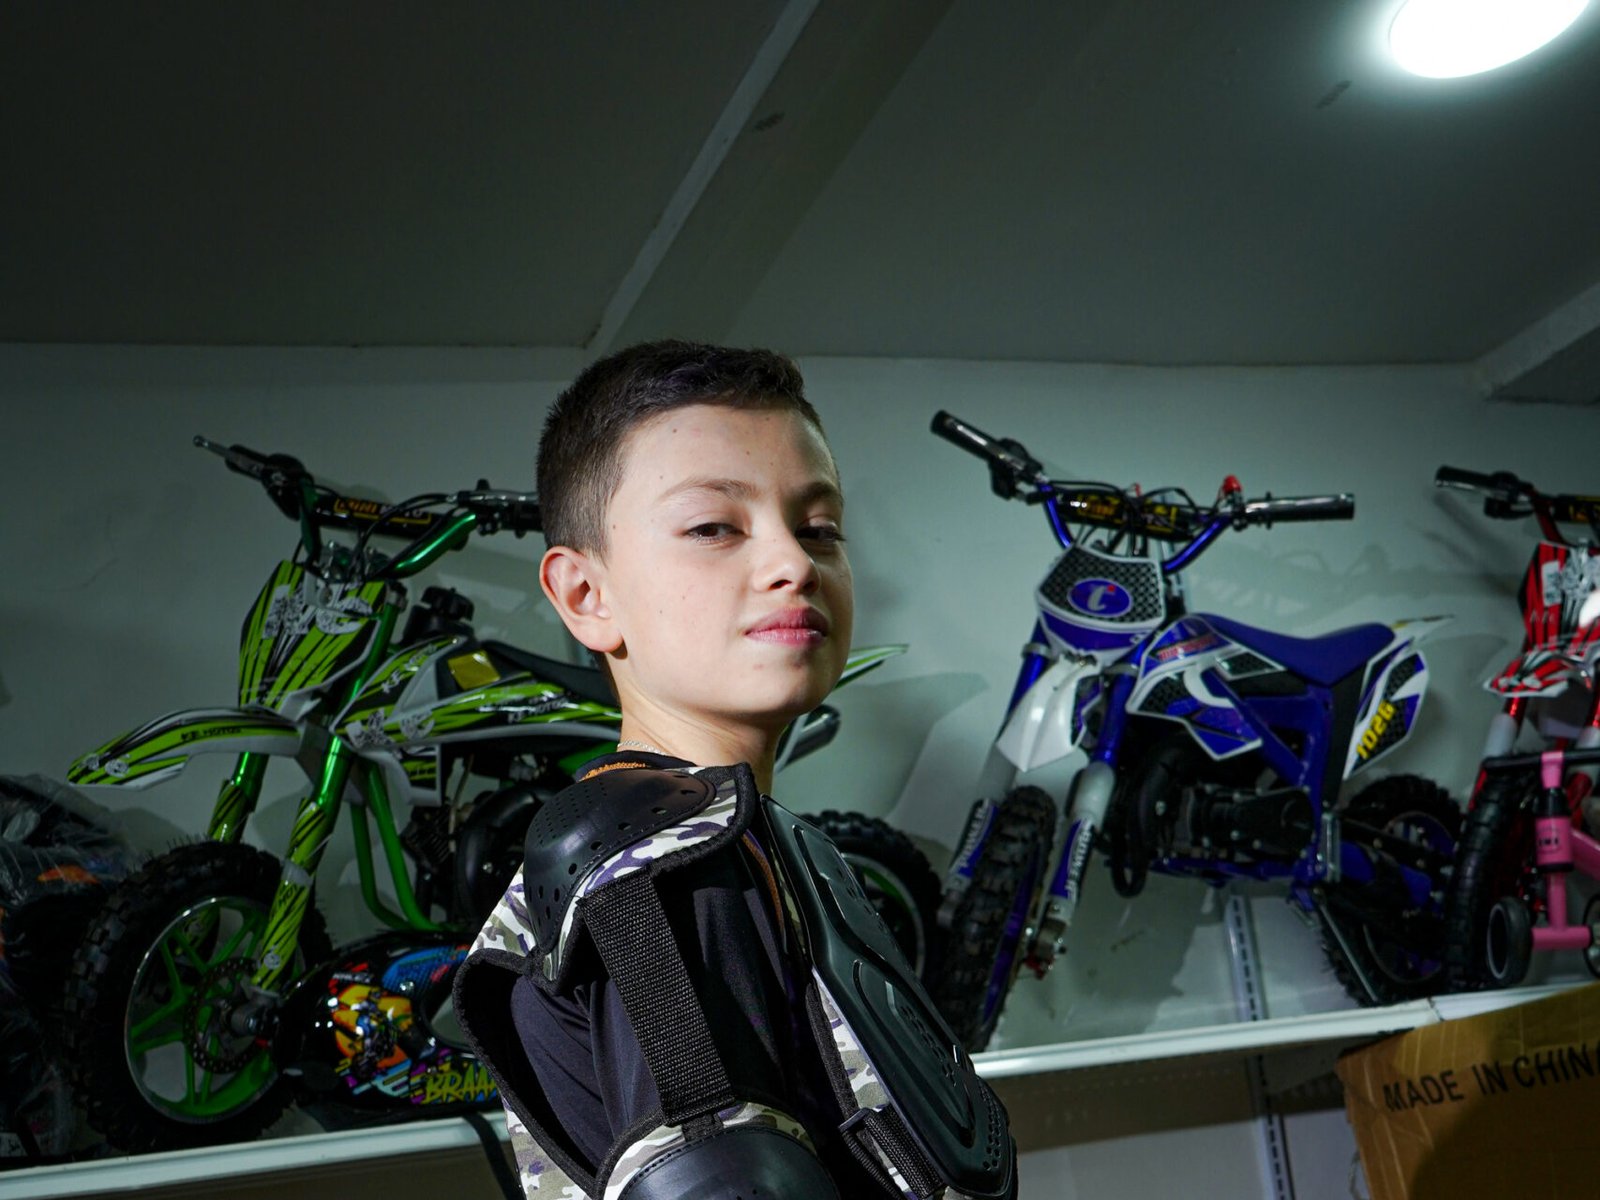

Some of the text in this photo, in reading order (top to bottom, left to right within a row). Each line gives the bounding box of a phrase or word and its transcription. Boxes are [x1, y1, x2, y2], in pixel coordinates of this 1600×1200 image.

[1356, 700, 1395, 760] 1026
[1382, 1040, 1600, 1112] MADE IN CHIN
